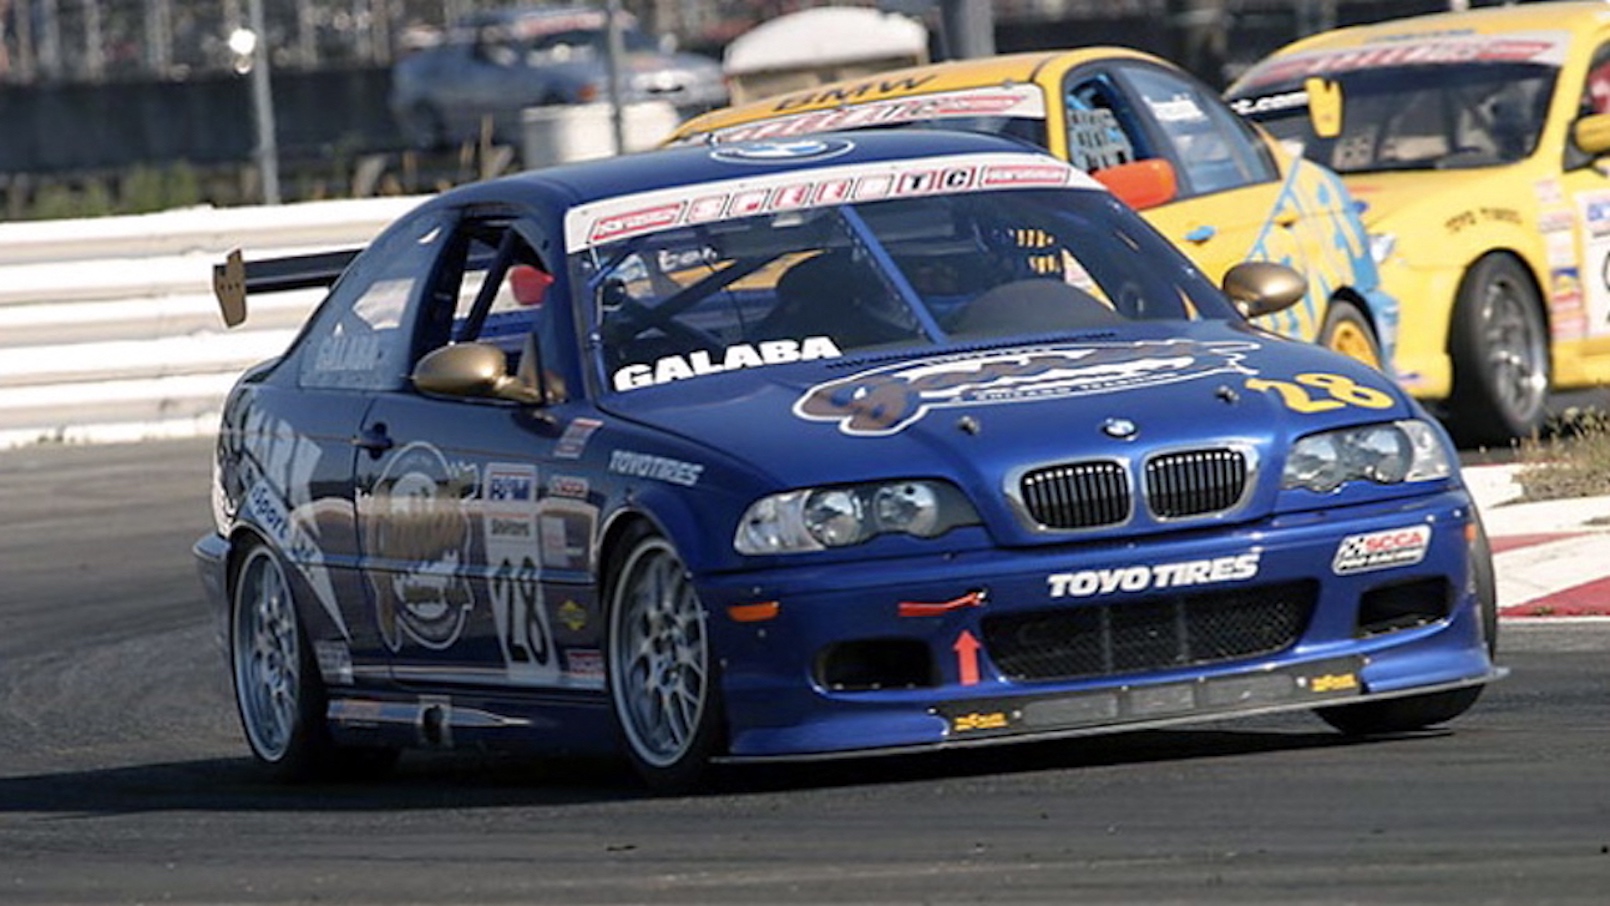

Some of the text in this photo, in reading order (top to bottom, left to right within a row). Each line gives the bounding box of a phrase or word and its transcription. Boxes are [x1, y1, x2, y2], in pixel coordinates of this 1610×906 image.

[612, 335, 842, 393] GALABA
[1245, 373, 1395, 413] 28
[1365, 532, 1424, 552] SCCA
[1047, 553, 1261, 598] TOYO TIRES
[494, 556, 549, 667] 28
